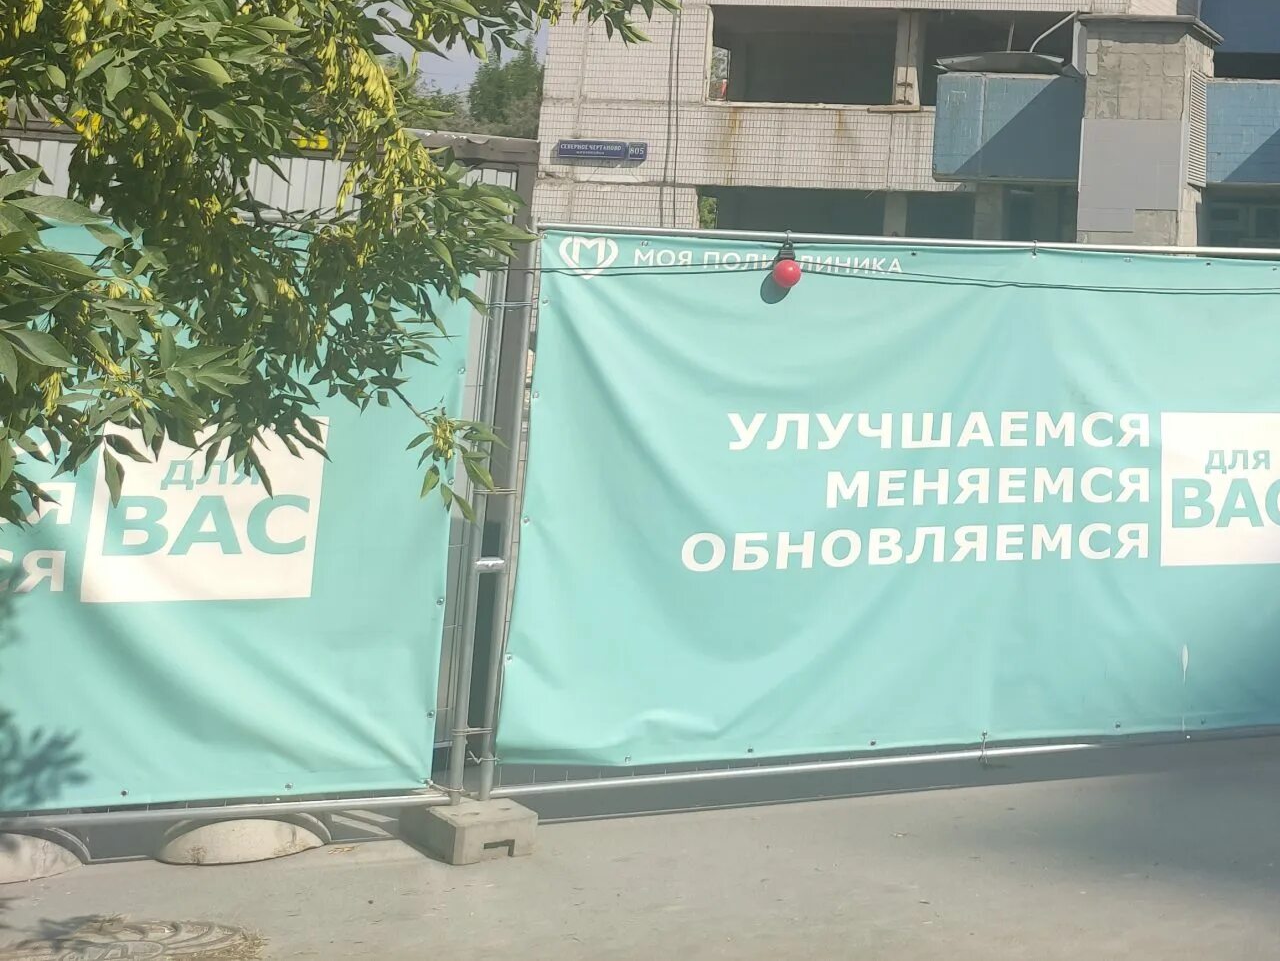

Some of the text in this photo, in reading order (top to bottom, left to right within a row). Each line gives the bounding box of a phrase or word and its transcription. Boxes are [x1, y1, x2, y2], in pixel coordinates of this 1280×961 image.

[629, 147, 644, 155] 805
[634, 248, 903, 274] МОЯ ПОЛИЛИНИКА
[728, 411, 1151, 451] УЛУЧШАЕМСЯ
[1204, 449, 1272, 475] ДЛЯ
[826, 467, 1151, 509] МЕНЯЕМСЯ
[101, 494, 311, 557] ВАС
[681, 522, 1151, 572] ОБНОВЛЯЕМСЯ
